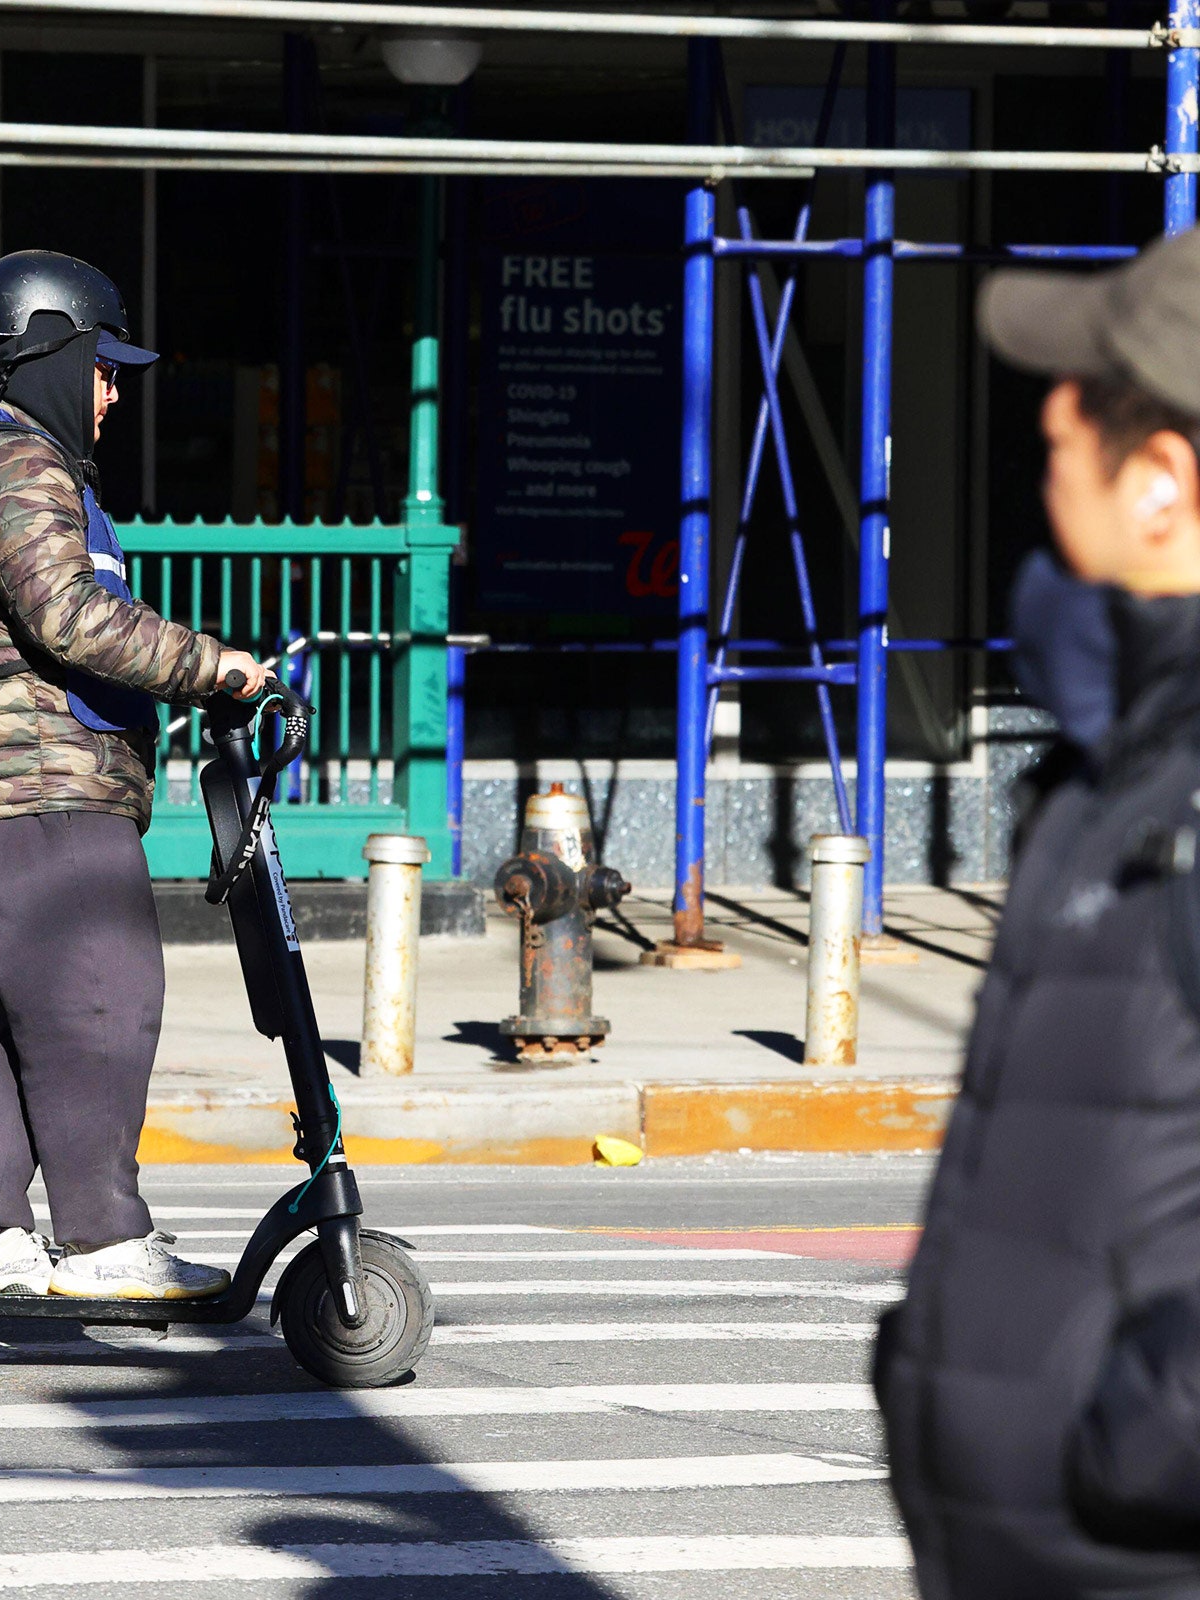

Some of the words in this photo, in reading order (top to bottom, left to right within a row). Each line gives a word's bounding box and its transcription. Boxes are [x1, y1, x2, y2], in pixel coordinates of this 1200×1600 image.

[501, 255, 595, 289] FREE
[499, 294, 552, 334] flu
[507, 383, 577, 400] COVID-19
[506, 408, 570, 427] Shingles
[506, 432, 591, 449] Pneumonia
[507, 457, 582, 477] Whooping
[585, 458, 631, 477] cough
[525, 482, 554, 497] and
[557, 484, 597, 497] more
[272, 872, 282, 895] Covered
